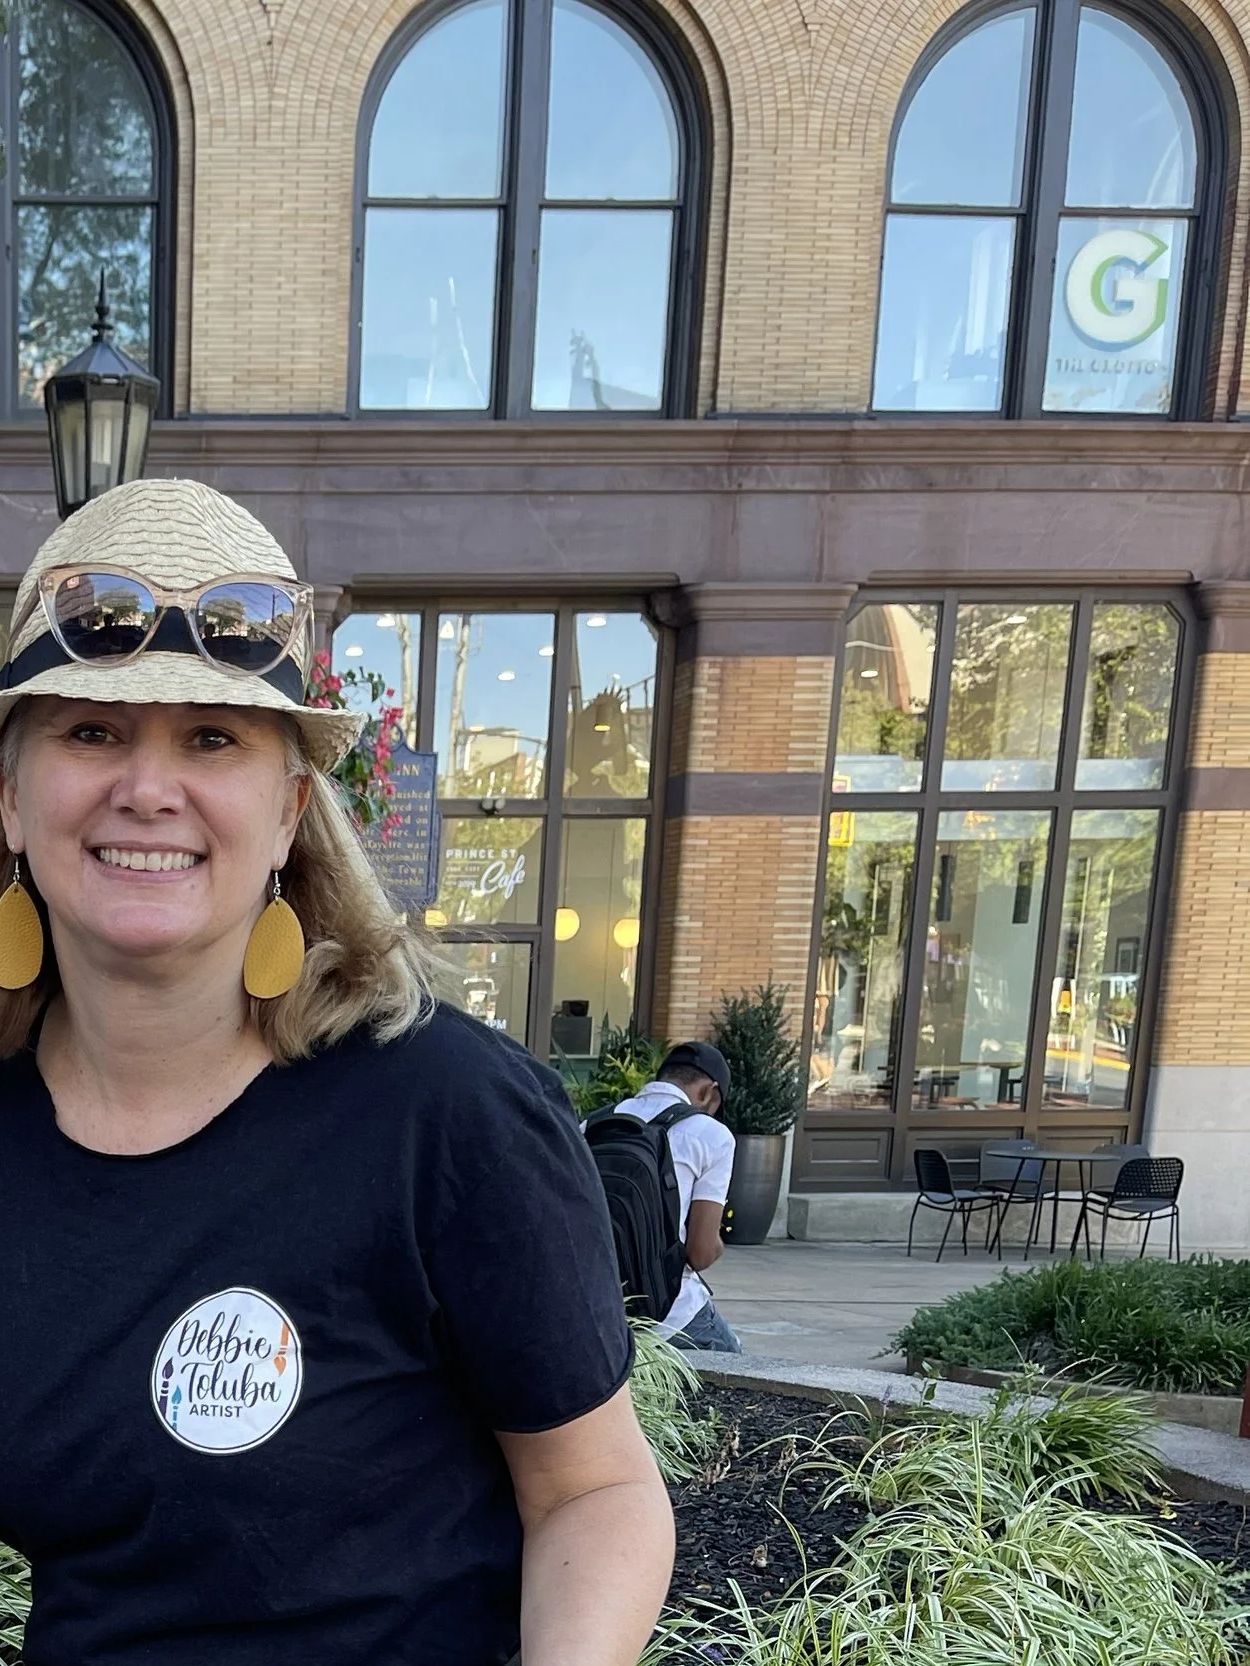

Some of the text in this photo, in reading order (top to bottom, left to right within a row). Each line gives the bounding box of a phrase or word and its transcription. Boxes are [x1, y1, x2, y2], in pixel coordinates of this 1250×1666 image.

[446, 849, 516, 859] PRINCE ST
[177, 1312, 271, 1363] Debbie
[181, 1360, 281, 1408] Toluba
[189, 1404, 243, 1418] ARTIST
